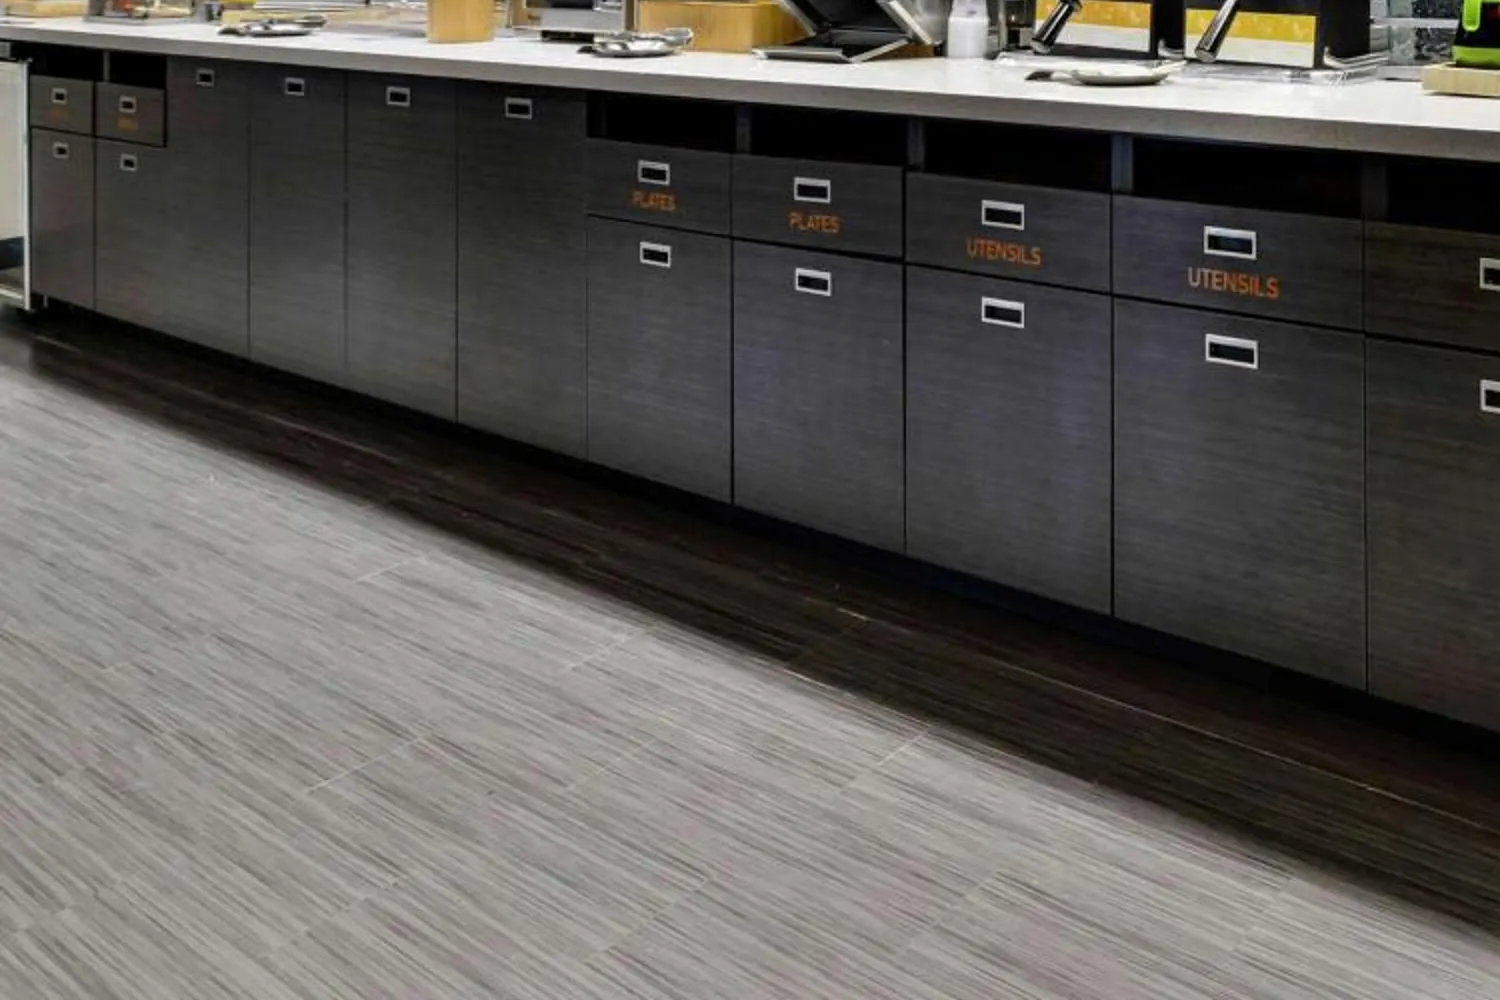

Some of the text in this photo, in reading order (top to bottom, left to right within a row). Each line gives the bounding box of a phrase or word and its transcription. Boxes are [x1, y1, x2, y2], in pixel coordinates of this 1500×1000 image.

[631, 190, 676, 212] PLATES
[789, 211, 840, 233] PLATES
[966, 237, 1042, 266] UTENSILS
[1187, 266, 1280, 299] UTENSILS
